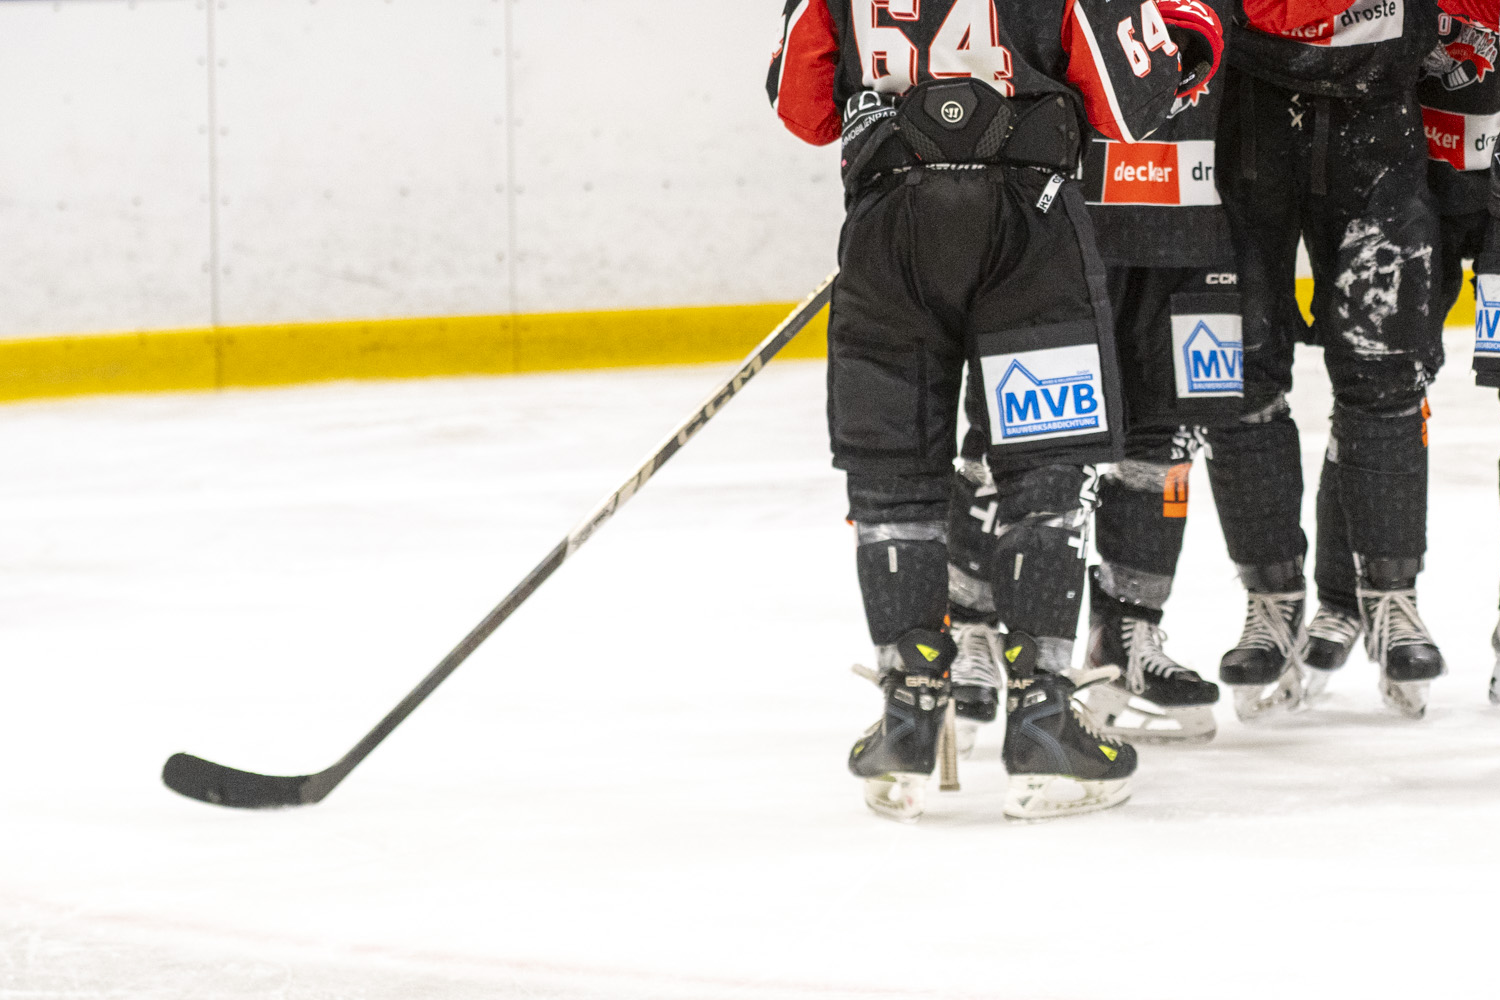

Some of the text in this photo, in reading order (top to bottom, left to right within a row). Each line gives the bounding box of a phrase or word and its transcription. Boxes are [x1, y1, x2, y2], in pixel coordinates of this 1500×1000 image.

[1340, 0, 1397, 28] droste
[1281, 21, 1329, 39] ker
[1113, 161, 1173, 183] decker
[1205, 273, 1238, 285] CCM
[1192, 350, 1243, 379] MV
[1005, 383, 1098, 424] MVB
[1006, 417, 1096, 435] BAUWERKSABDICHTUNG
